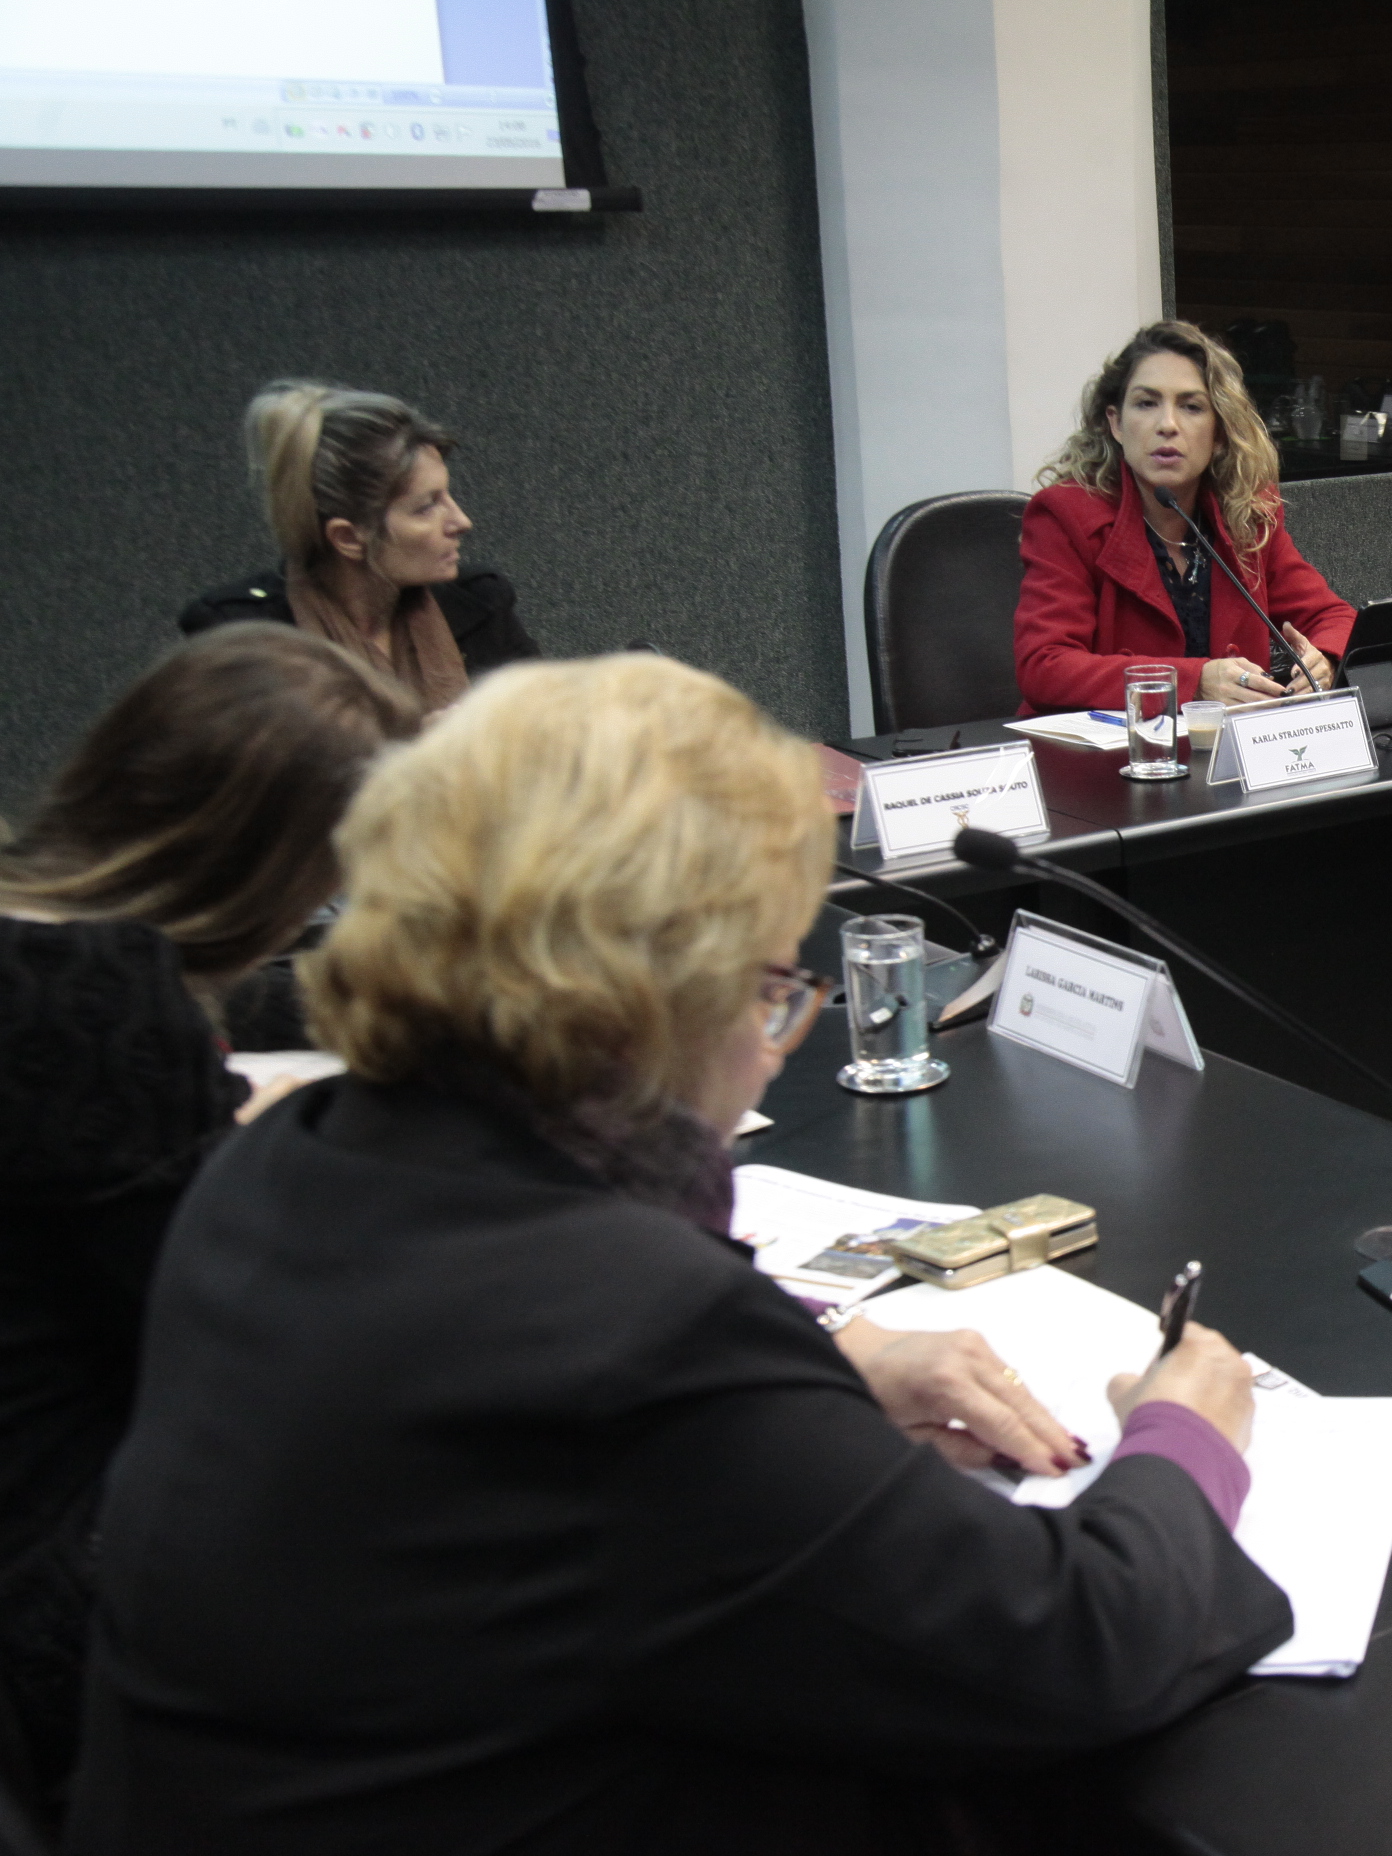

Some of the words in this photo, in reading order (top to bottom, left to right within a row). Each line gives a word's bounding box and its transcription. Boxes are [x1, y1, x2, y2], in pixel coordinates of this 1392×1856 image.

[1252, 734, 1277, 744] KARLA
[1278, 727, 1314, 740] STRAIOTO
[1315, 720, 1354, 734] SPESSATTO
[1285, 761, 1315, 773] FATMA
[884, 798, 919, 811] RAQUEL
[920, 796, 932, 806] DE
[934, 791, 965, 803] CASSIA
[999, 781, 1028, 792] SUTO
[1057, 977, 1087, 998] GARCIA
[1088, 989, 1125, 1012] MARTINS
